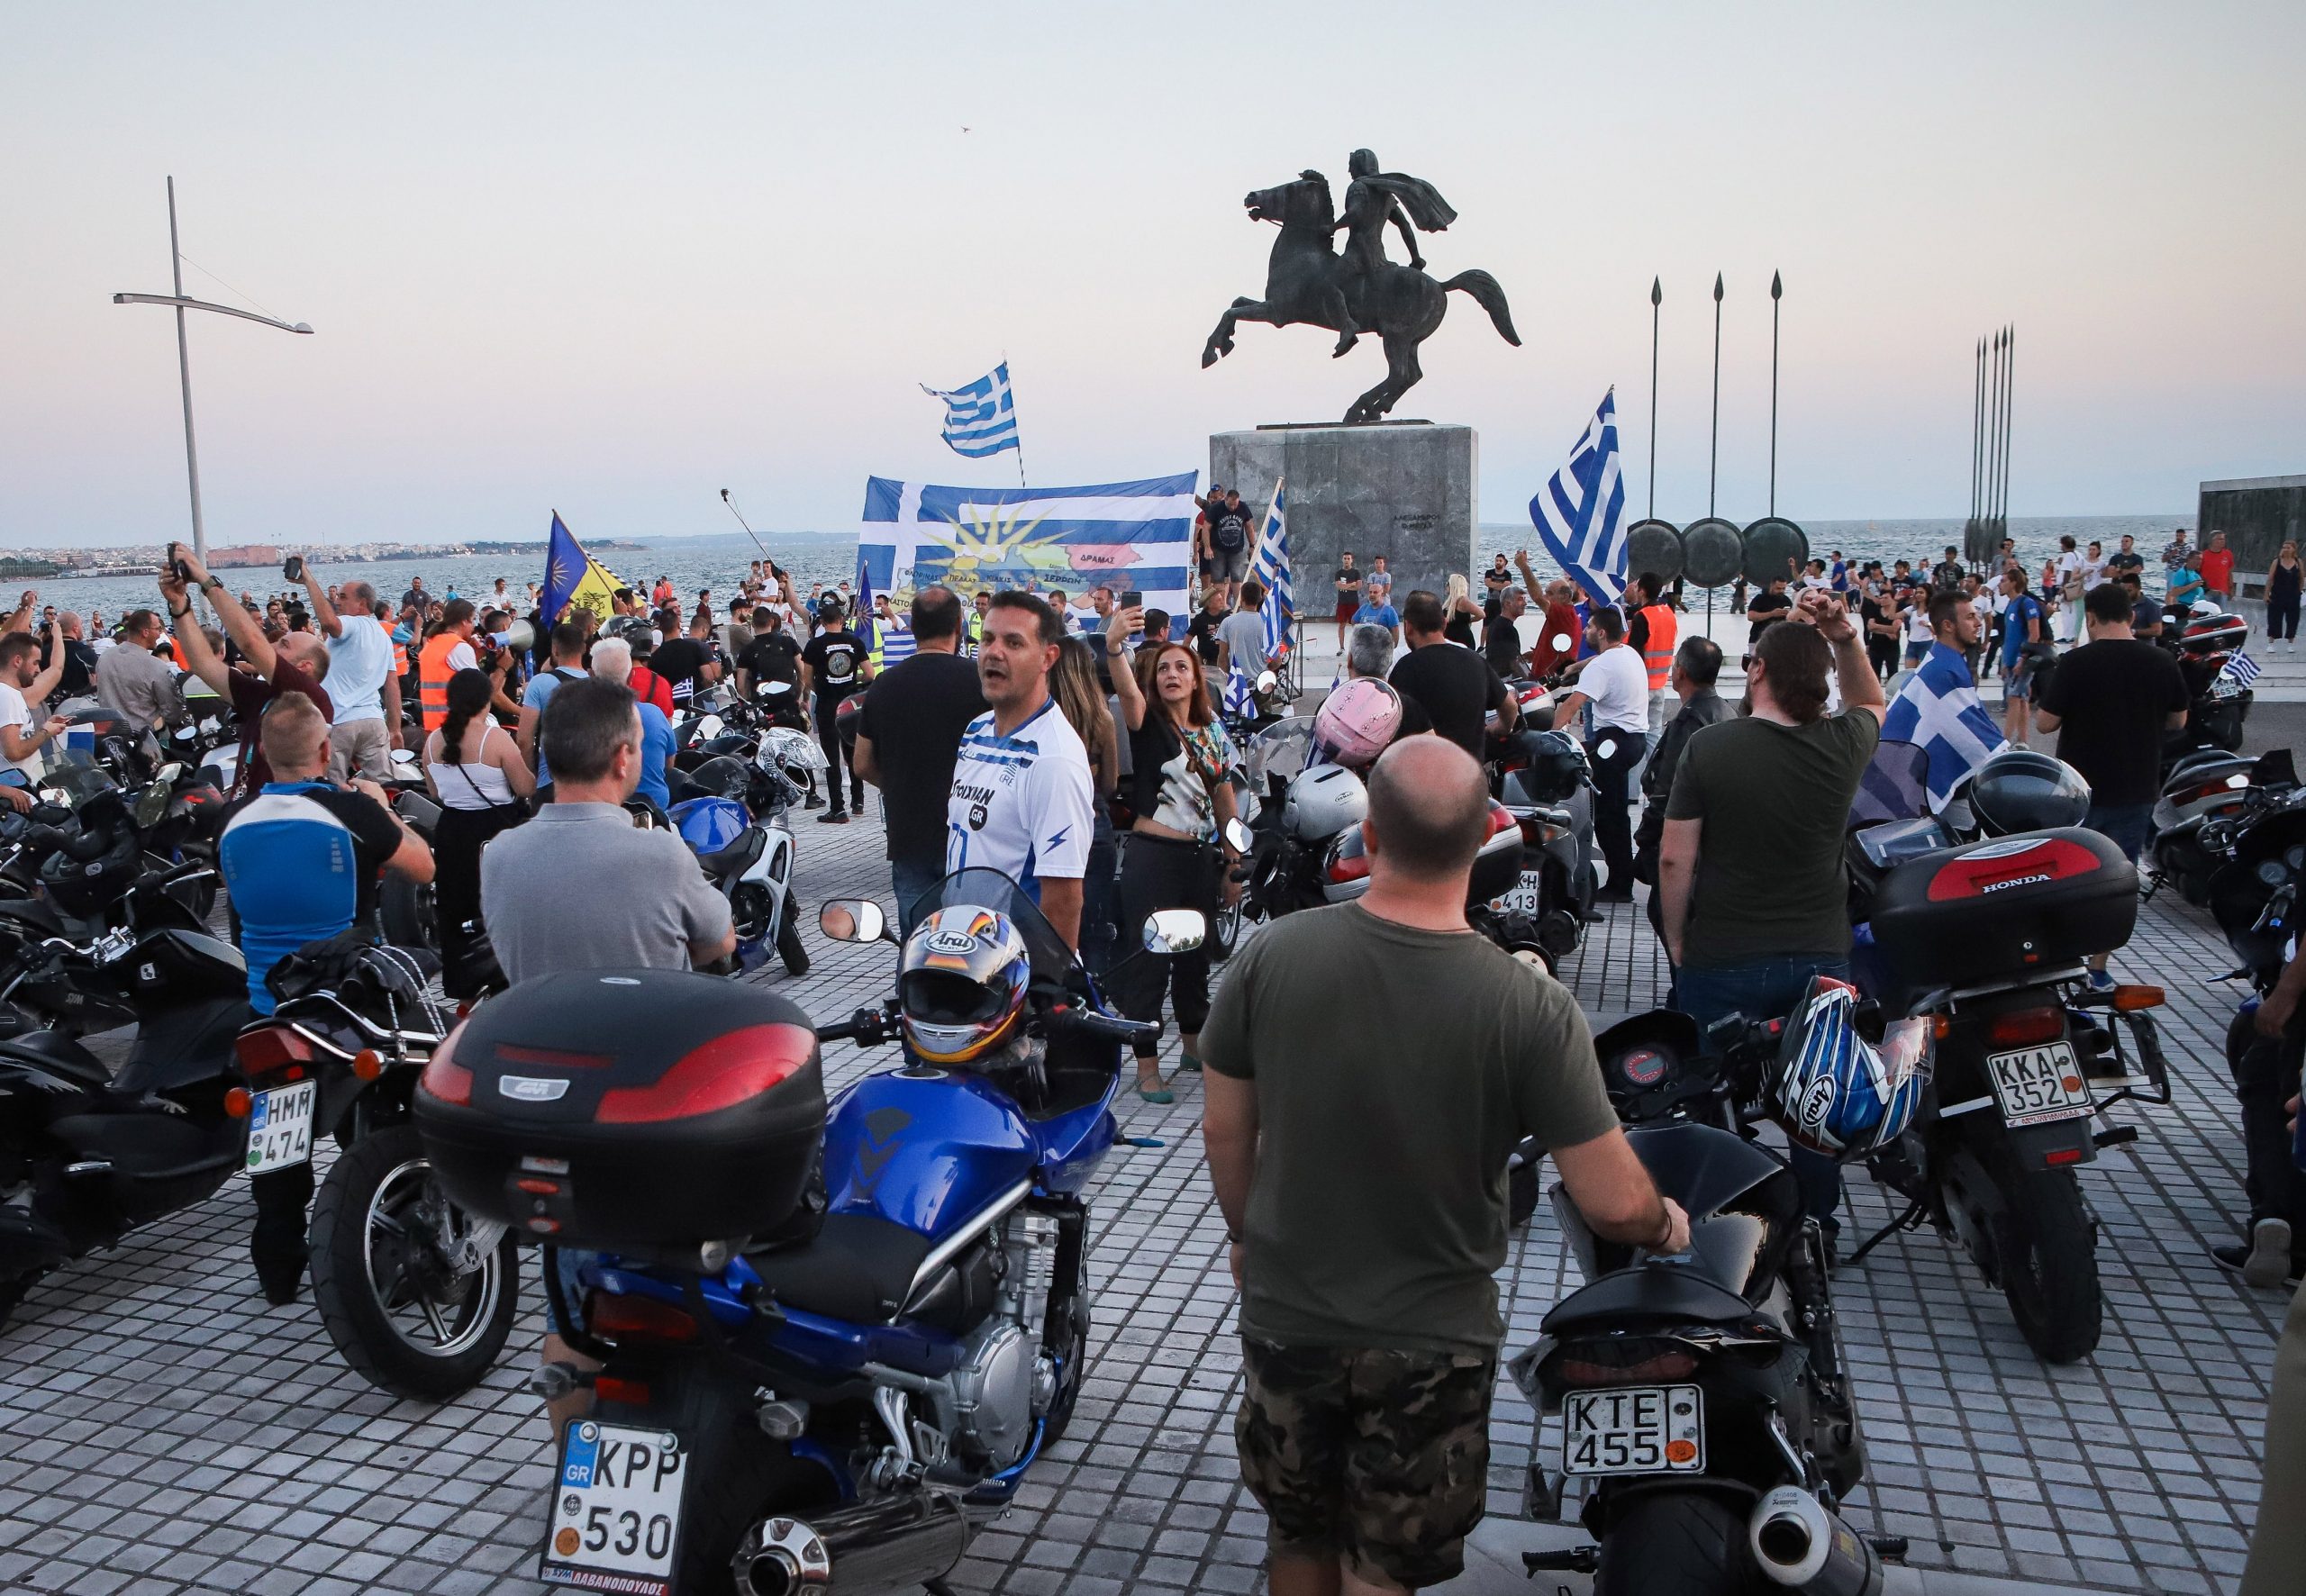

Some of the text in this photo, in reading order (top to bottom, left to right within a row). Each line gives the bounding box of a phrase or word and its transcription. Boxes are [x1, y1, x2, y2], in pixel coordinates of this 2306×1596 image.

[1080, 554, 1115, 565] ΔΡΑΜΑΣ
[1043, 574, 1082, 585] ΣΕΡΡΩΝ
[1983, 874, 2052, 893] HONDA
[1503, 894, 1536, 910] 413
[929, 933, 970, 948] Arai
[1994, 1052, 2054, 1085] KKA
[268, 1089, 312, 1125] HMM
[1806, 1077, 1830, 1122] Arai
[2005, 1078, 2063, 1111] 352
[252, 1116, 265, 1128] GR
[265, 1127, 305, 1161] 474
[1575, 1393, 1658, 1431] KTE
[1574, 1431, 1659, 1467] 455
[566, 1464, 590, 1483] GR
[593, 1440, 681, 1492] KPP
[586, 1506, 672, 1560] 530
[572, 1572, 665, 1596] ΔΑΒΑΝΟΠΟΥΛΟΣ
